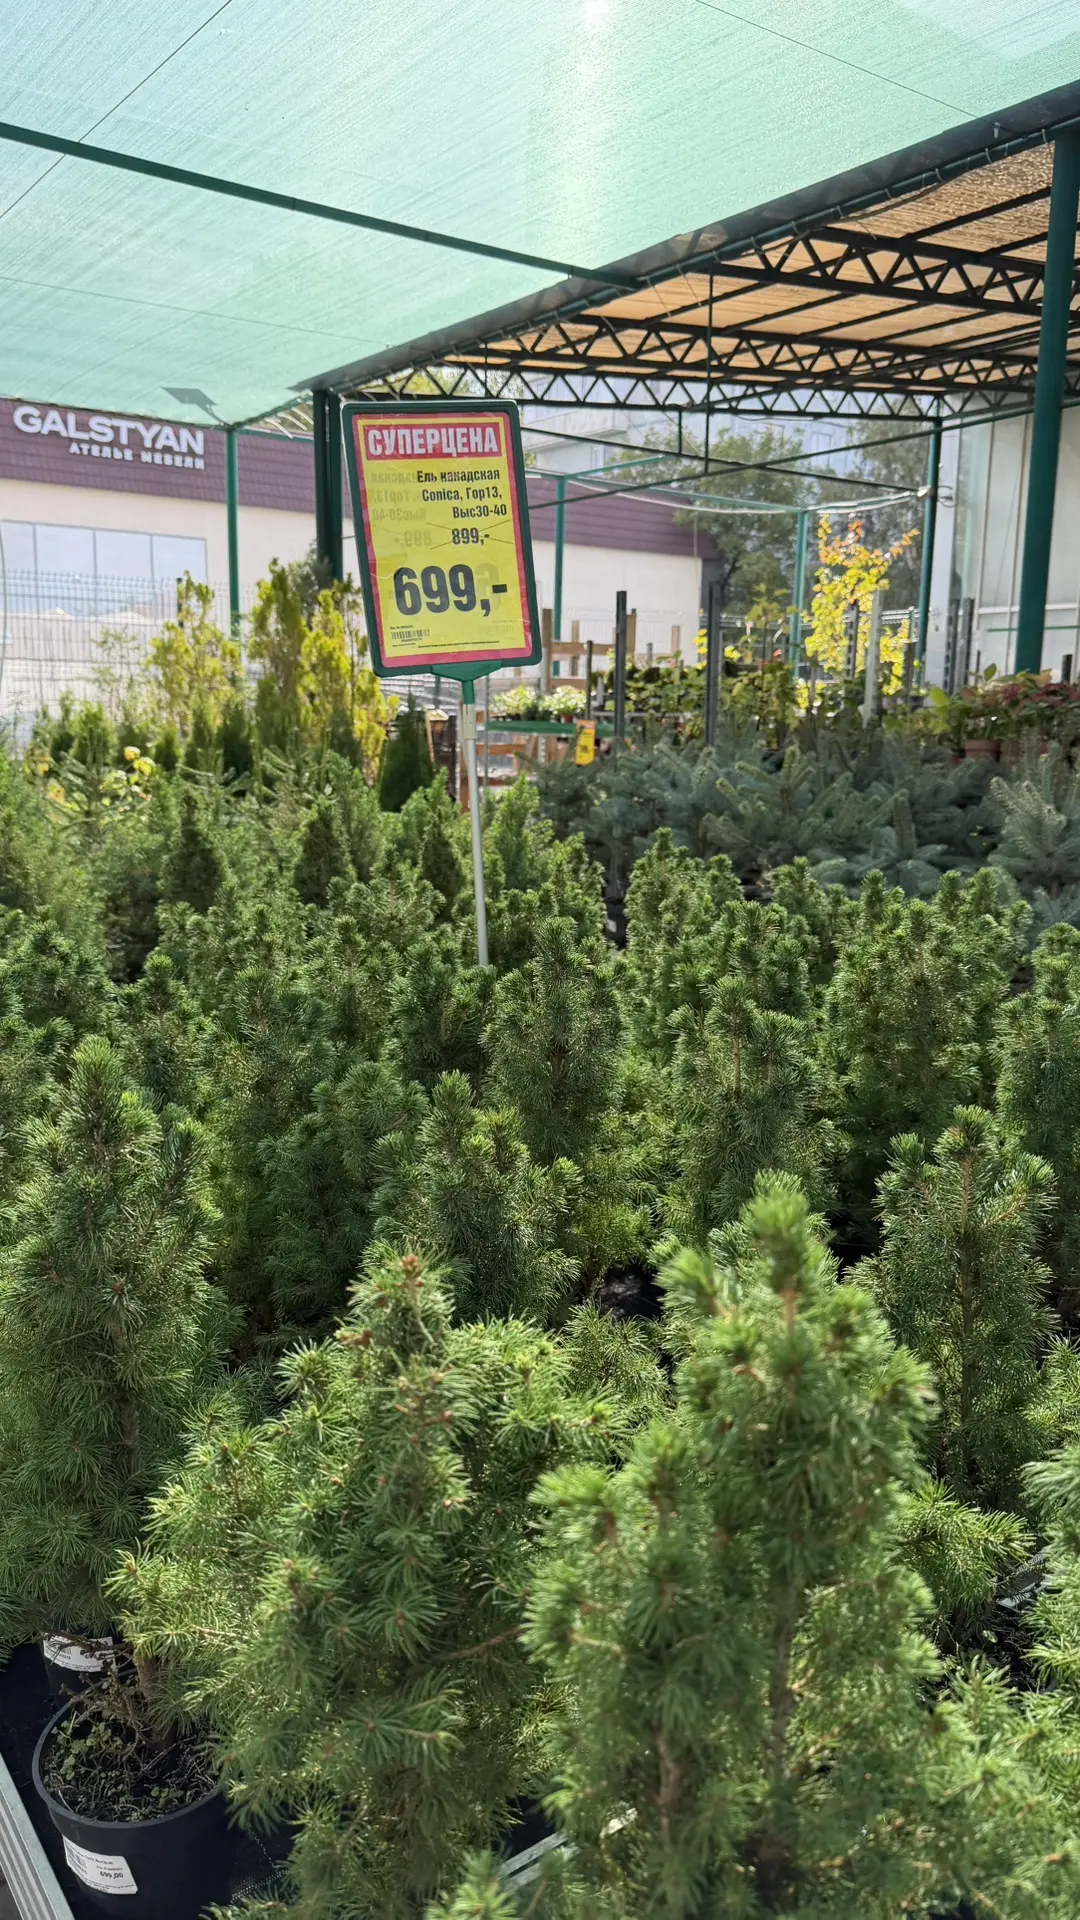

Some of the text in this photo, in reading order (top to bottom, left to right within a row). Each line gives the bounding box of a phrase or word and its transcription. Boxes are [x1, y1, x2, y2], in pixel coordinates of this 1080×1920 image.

[13, 405, 205, 455] GALSTYAN
[367, 426, 499, 457] СУПЕРЦЕНА
[69, 442, 134, 461] АТЕЛЬЕ
[417, 469, 500, 483] Ель канадская
[466, 486, 502, 502] Гор13,
[452, 504, 507, 519] Выс30-40
[452, 527, 490, 545] 899,-
[393, 564, 507, 617] 699,-
